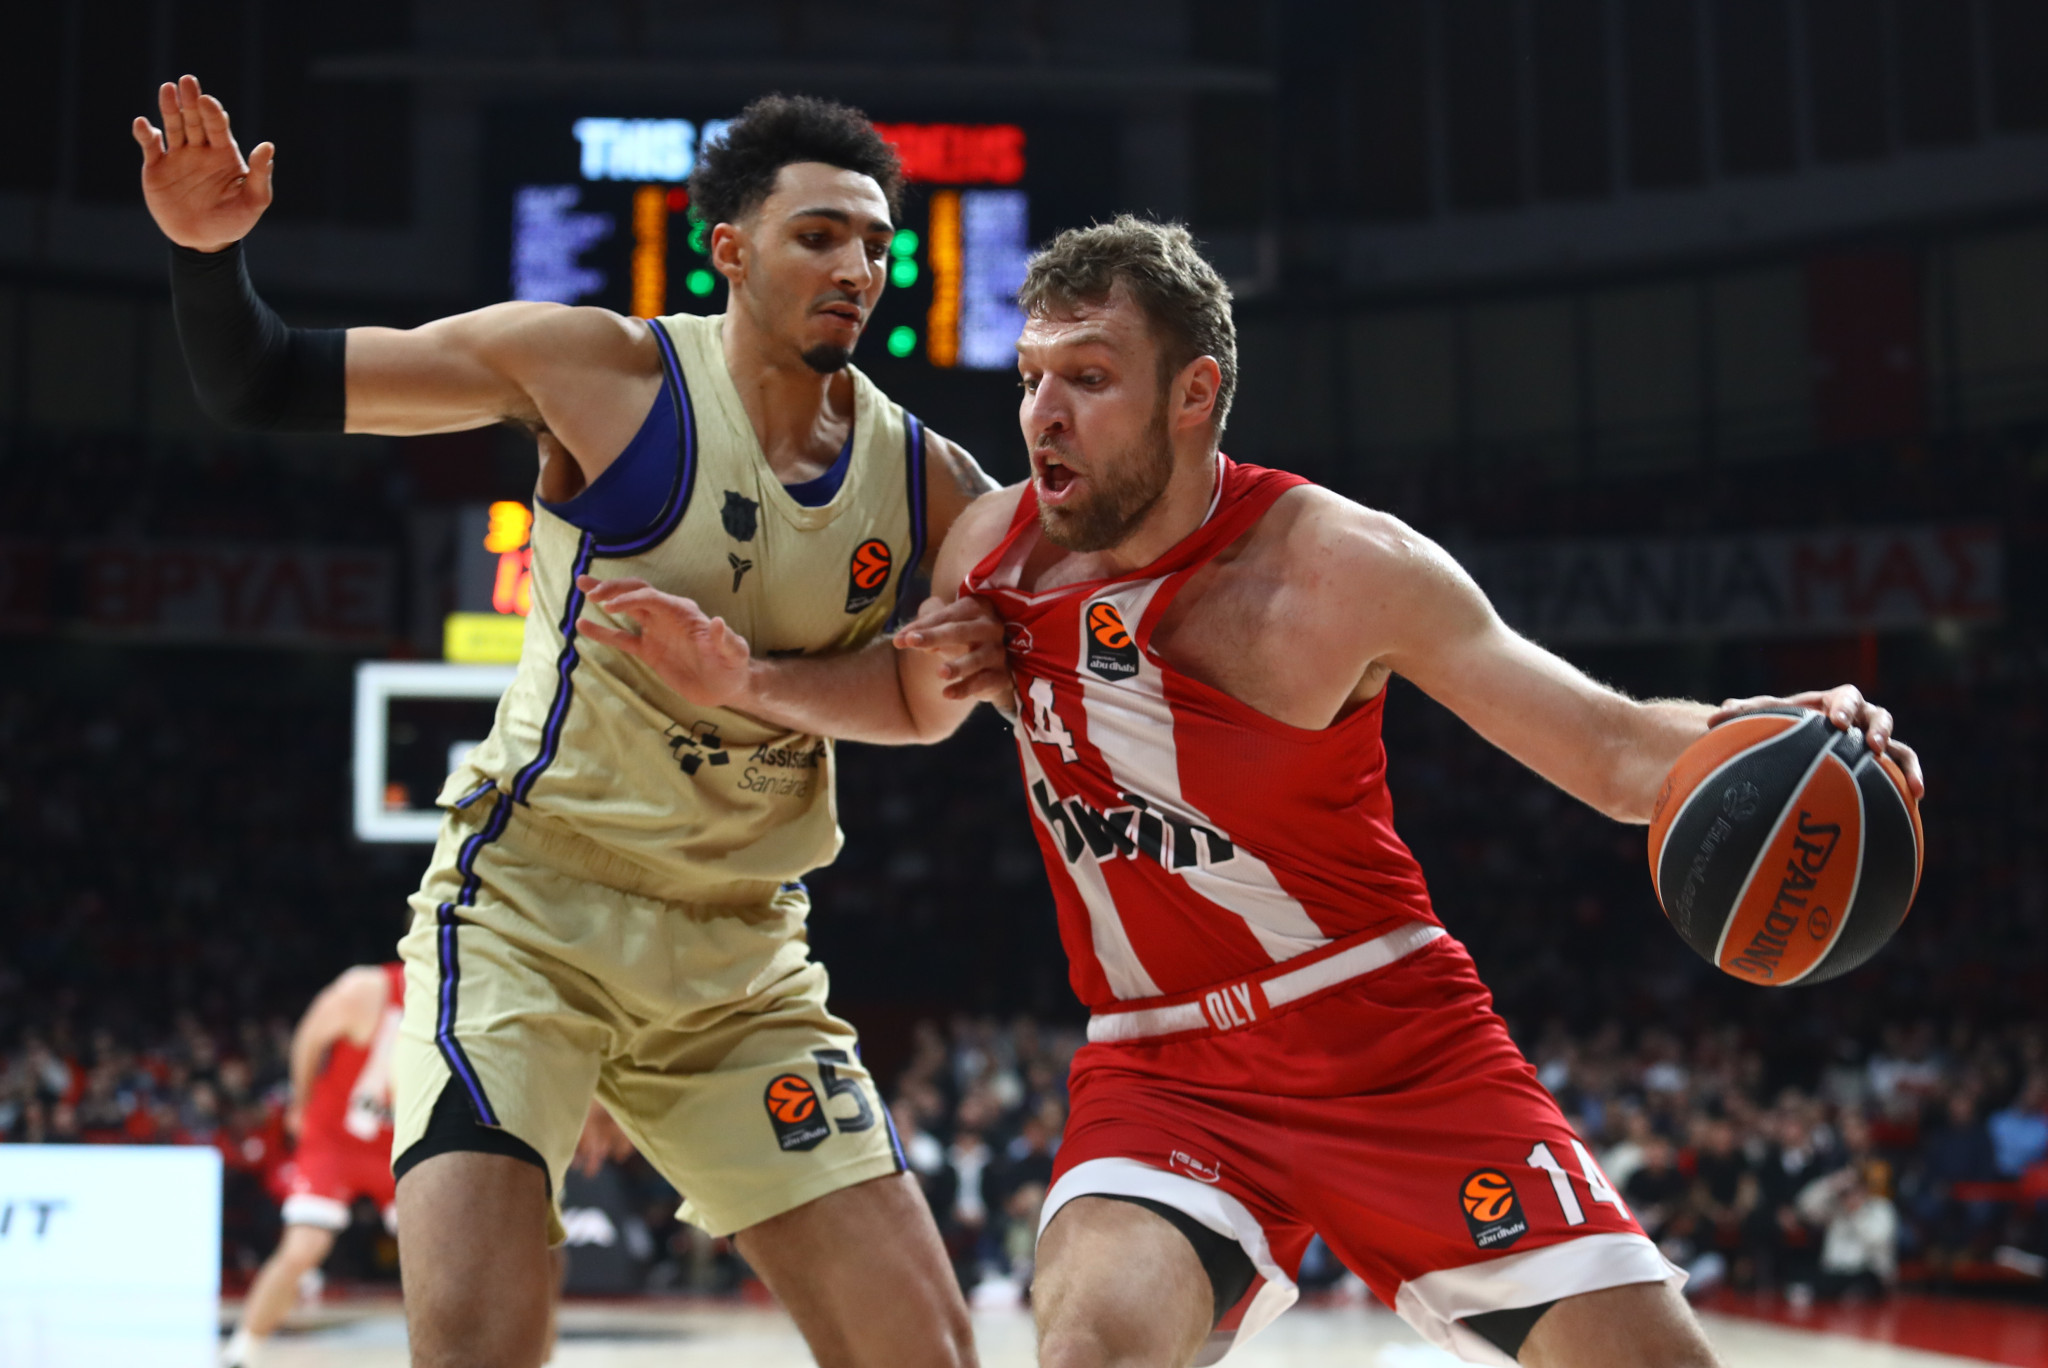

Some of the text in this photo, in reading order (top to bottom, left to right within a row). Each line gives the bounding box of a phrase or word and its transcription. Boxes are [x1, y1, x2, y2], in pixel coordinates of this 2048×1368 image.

[1031, 778, 1237, 873] bwin
[1729, 810, 1841, 980] SPALDING
[1205, 982, 1257, 1031] OLY
[811, 1049, 874, 1134] 5
[1525, 1138, 1632, 1227] 14
